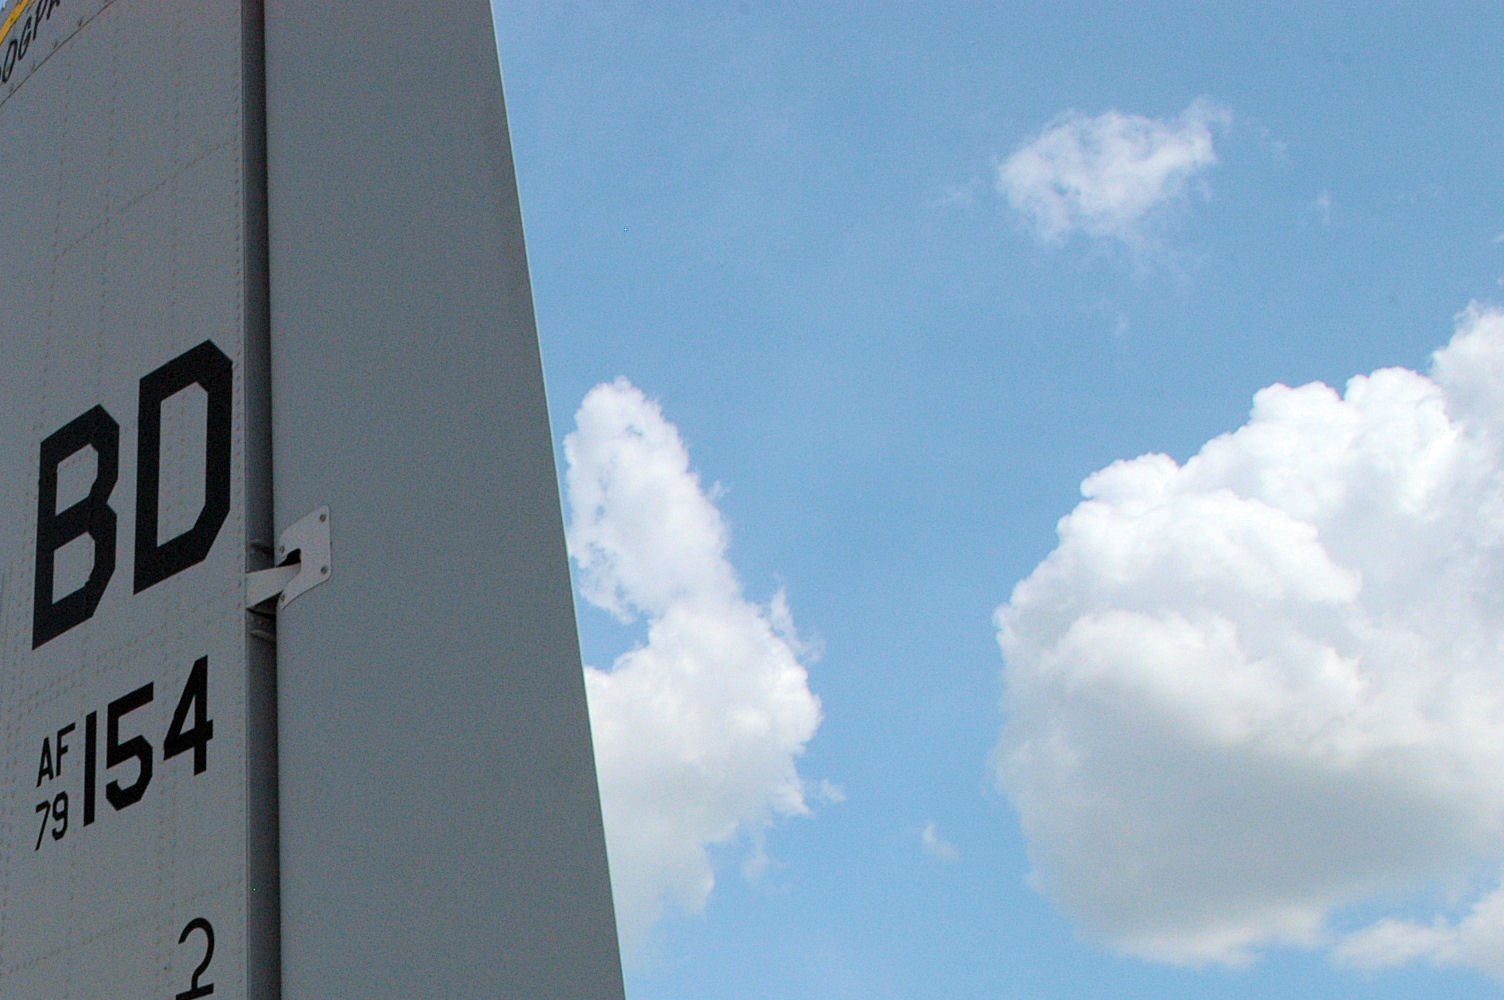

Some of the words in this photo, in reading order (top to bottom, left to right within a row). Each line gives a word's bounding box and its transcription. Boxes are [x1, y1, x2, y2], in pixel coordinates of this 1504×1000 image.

[32, 339, 233, 650] BD
[35, 722, 76, 788] AF
[83, 655, 214, 827] 154
[34, 791, 69, 852] 79
